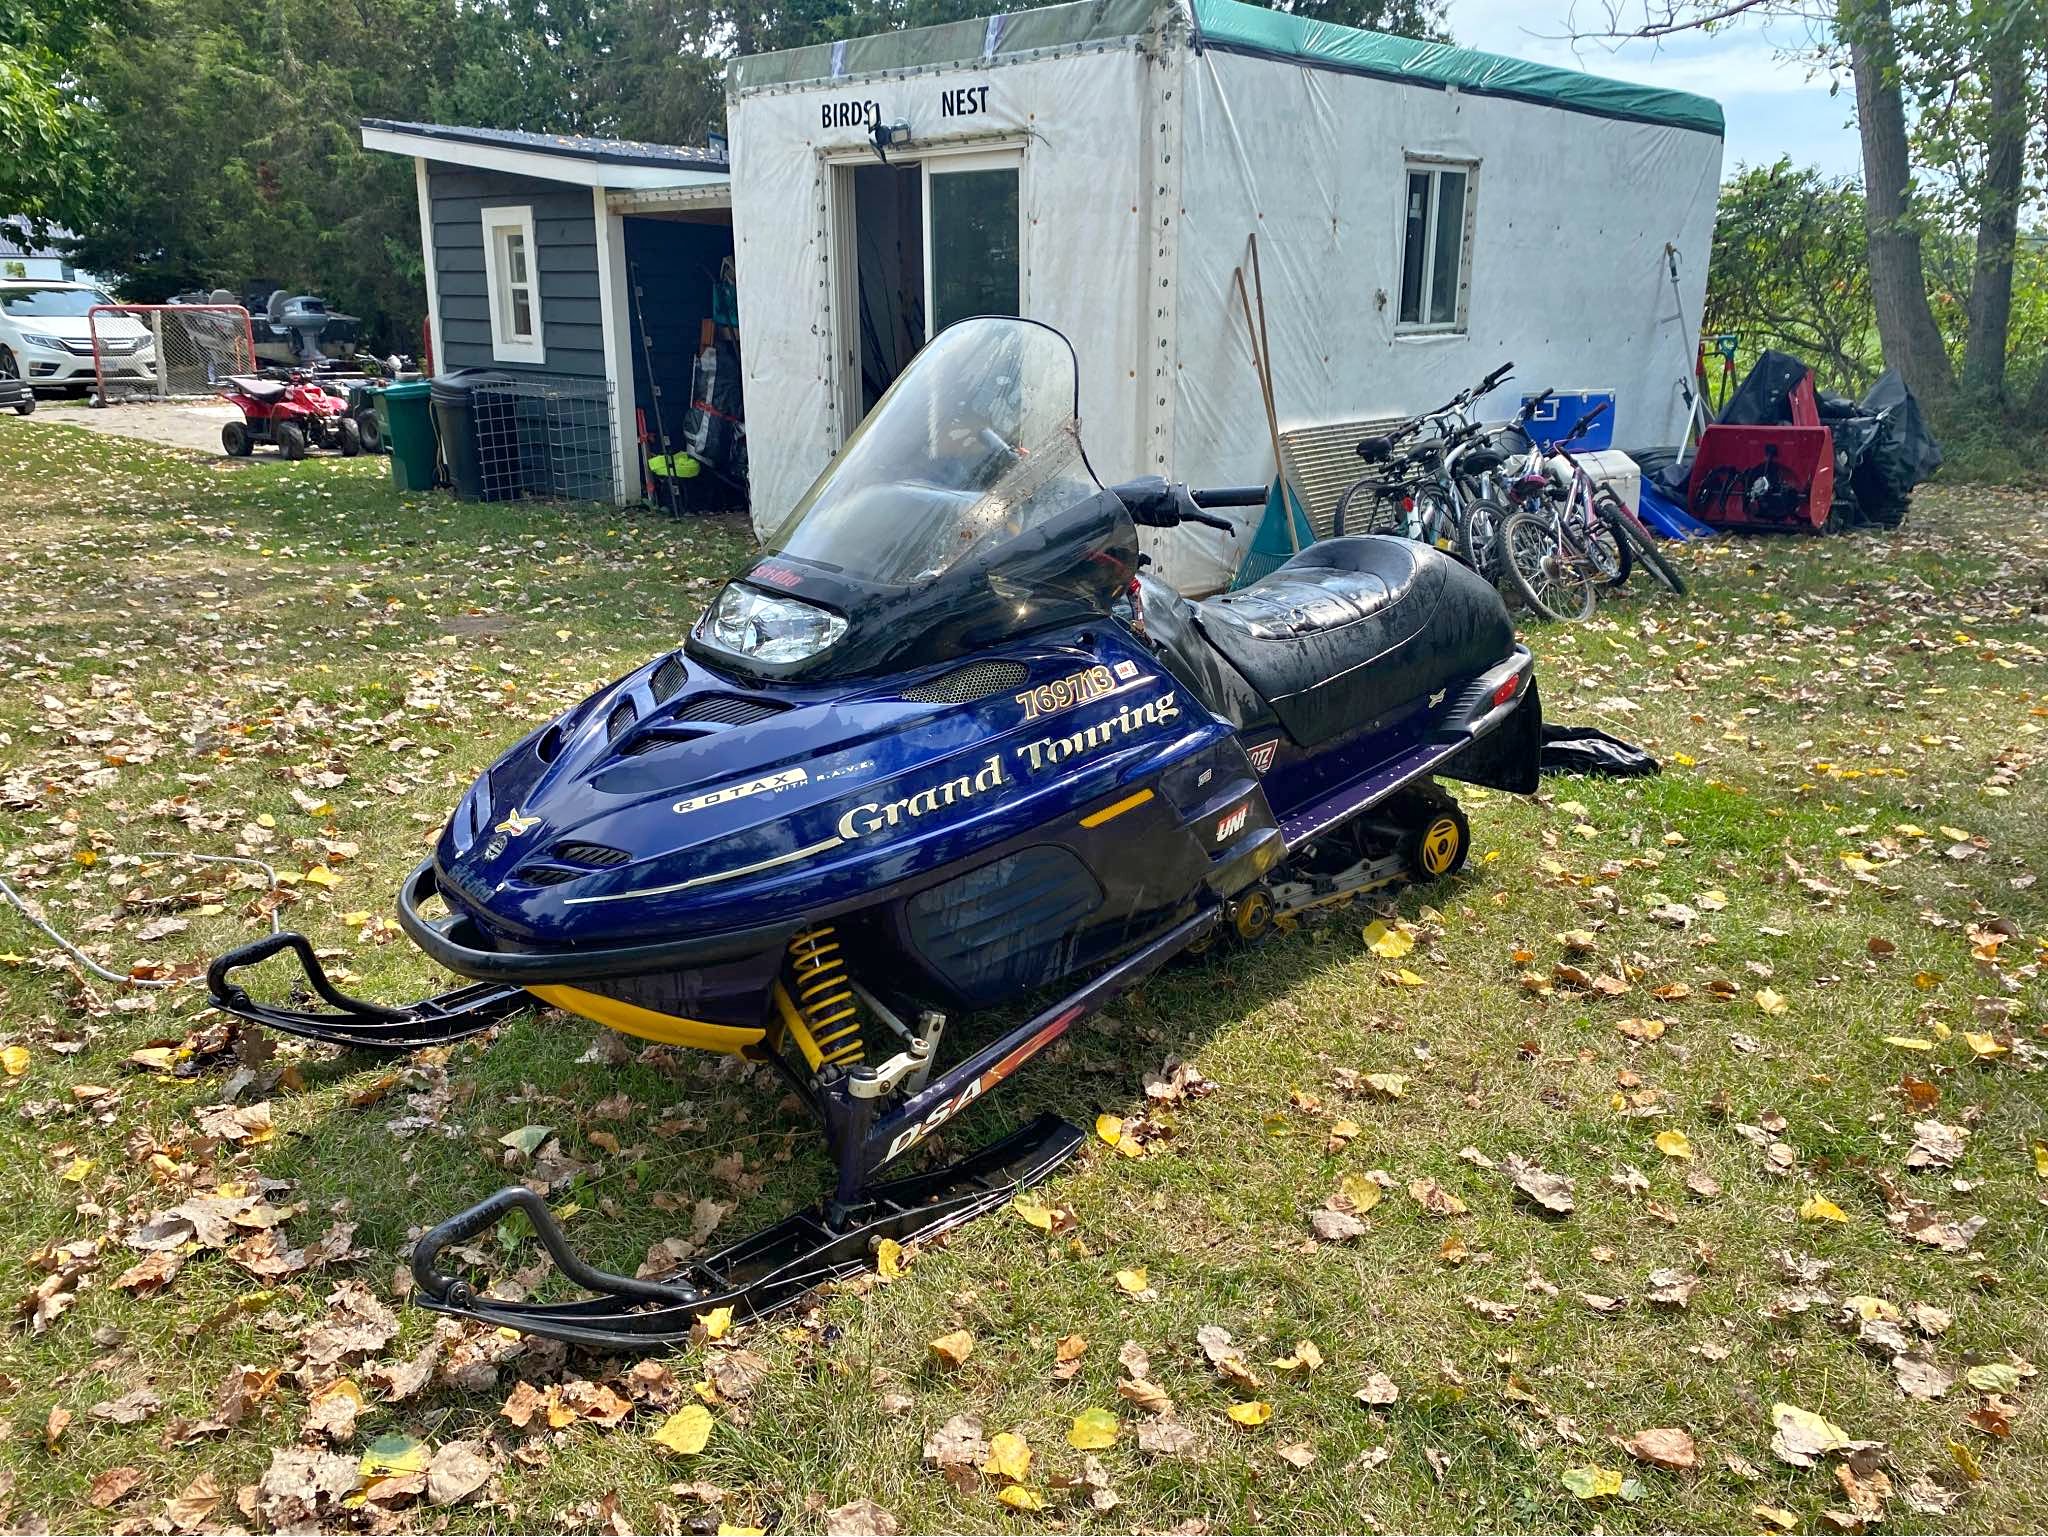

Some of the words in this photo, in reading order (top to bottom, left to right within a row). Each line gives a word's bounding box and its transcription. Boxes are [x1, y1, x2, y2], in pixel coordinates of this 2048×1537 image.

[822, 100, 872, 128] BIRDS
[941, 86, 989, 117] NEST
[1015, 665, 1115, 720] 769713
[774, 779, 809, 793] WITH
[838, 754, 1004, 842] Grand
[1017, 690, 1180, 770] Touring
[678, 774, 788, 812] ROTAX
[885, 1077, 982, 1163] DSA
